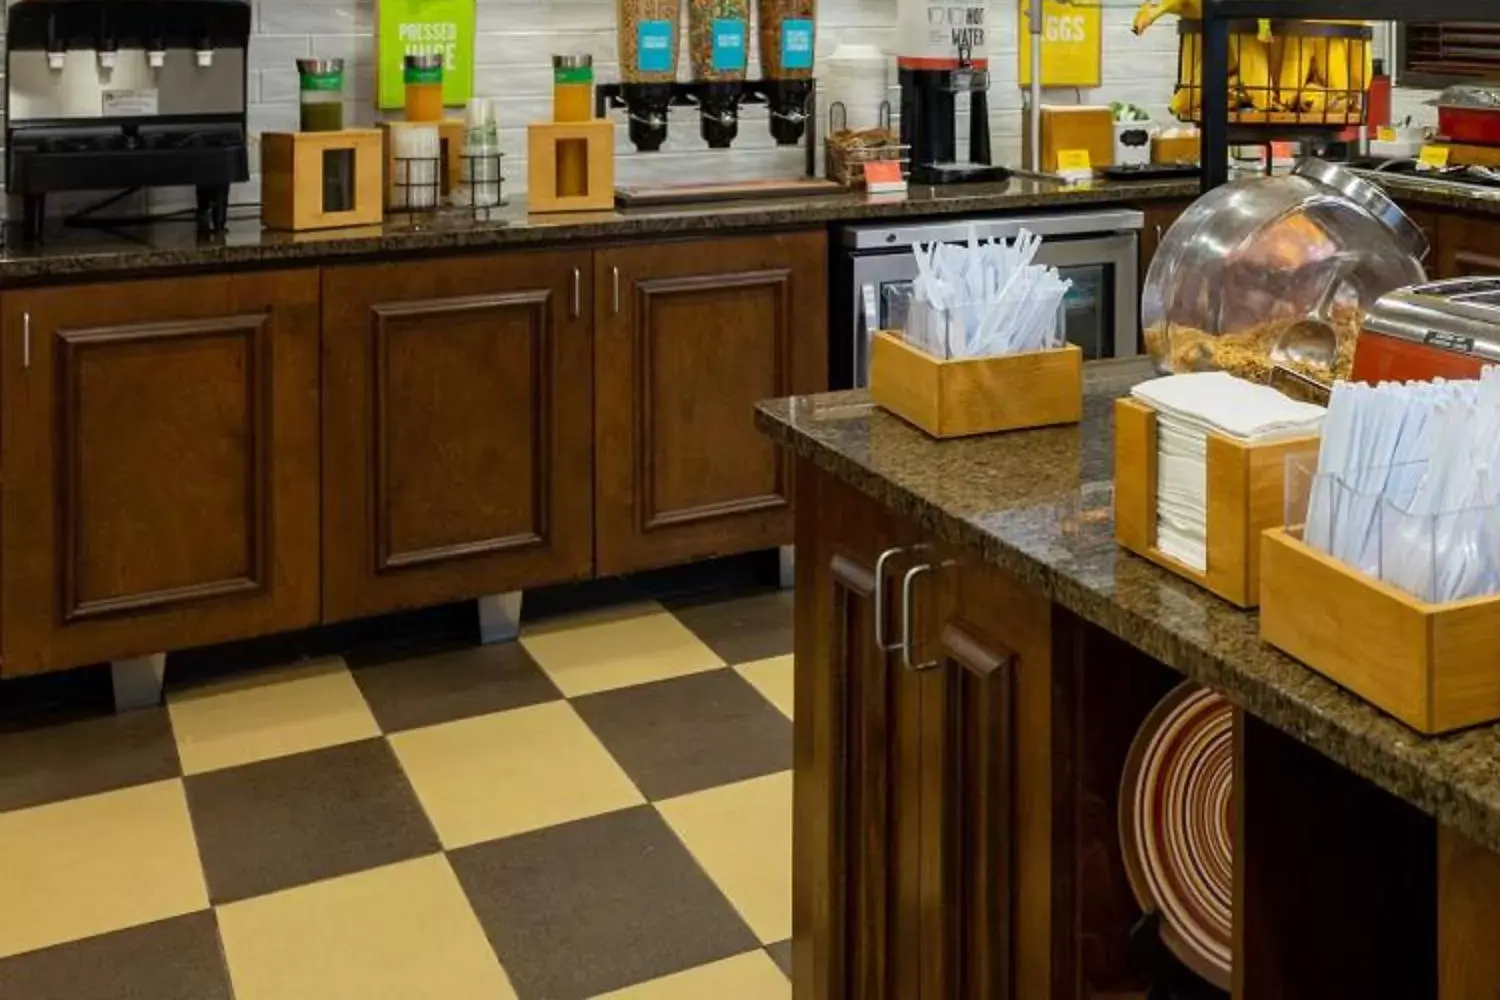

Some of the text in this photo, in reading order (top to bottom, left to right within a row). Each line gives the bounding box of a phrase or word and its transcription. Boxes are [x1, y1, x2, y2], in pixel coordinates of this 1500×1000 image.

[399, 23, 457, 41] PRESSED
[951, 27, 984, 47] WATER
[1041, 14, 1085, 41] GGS
